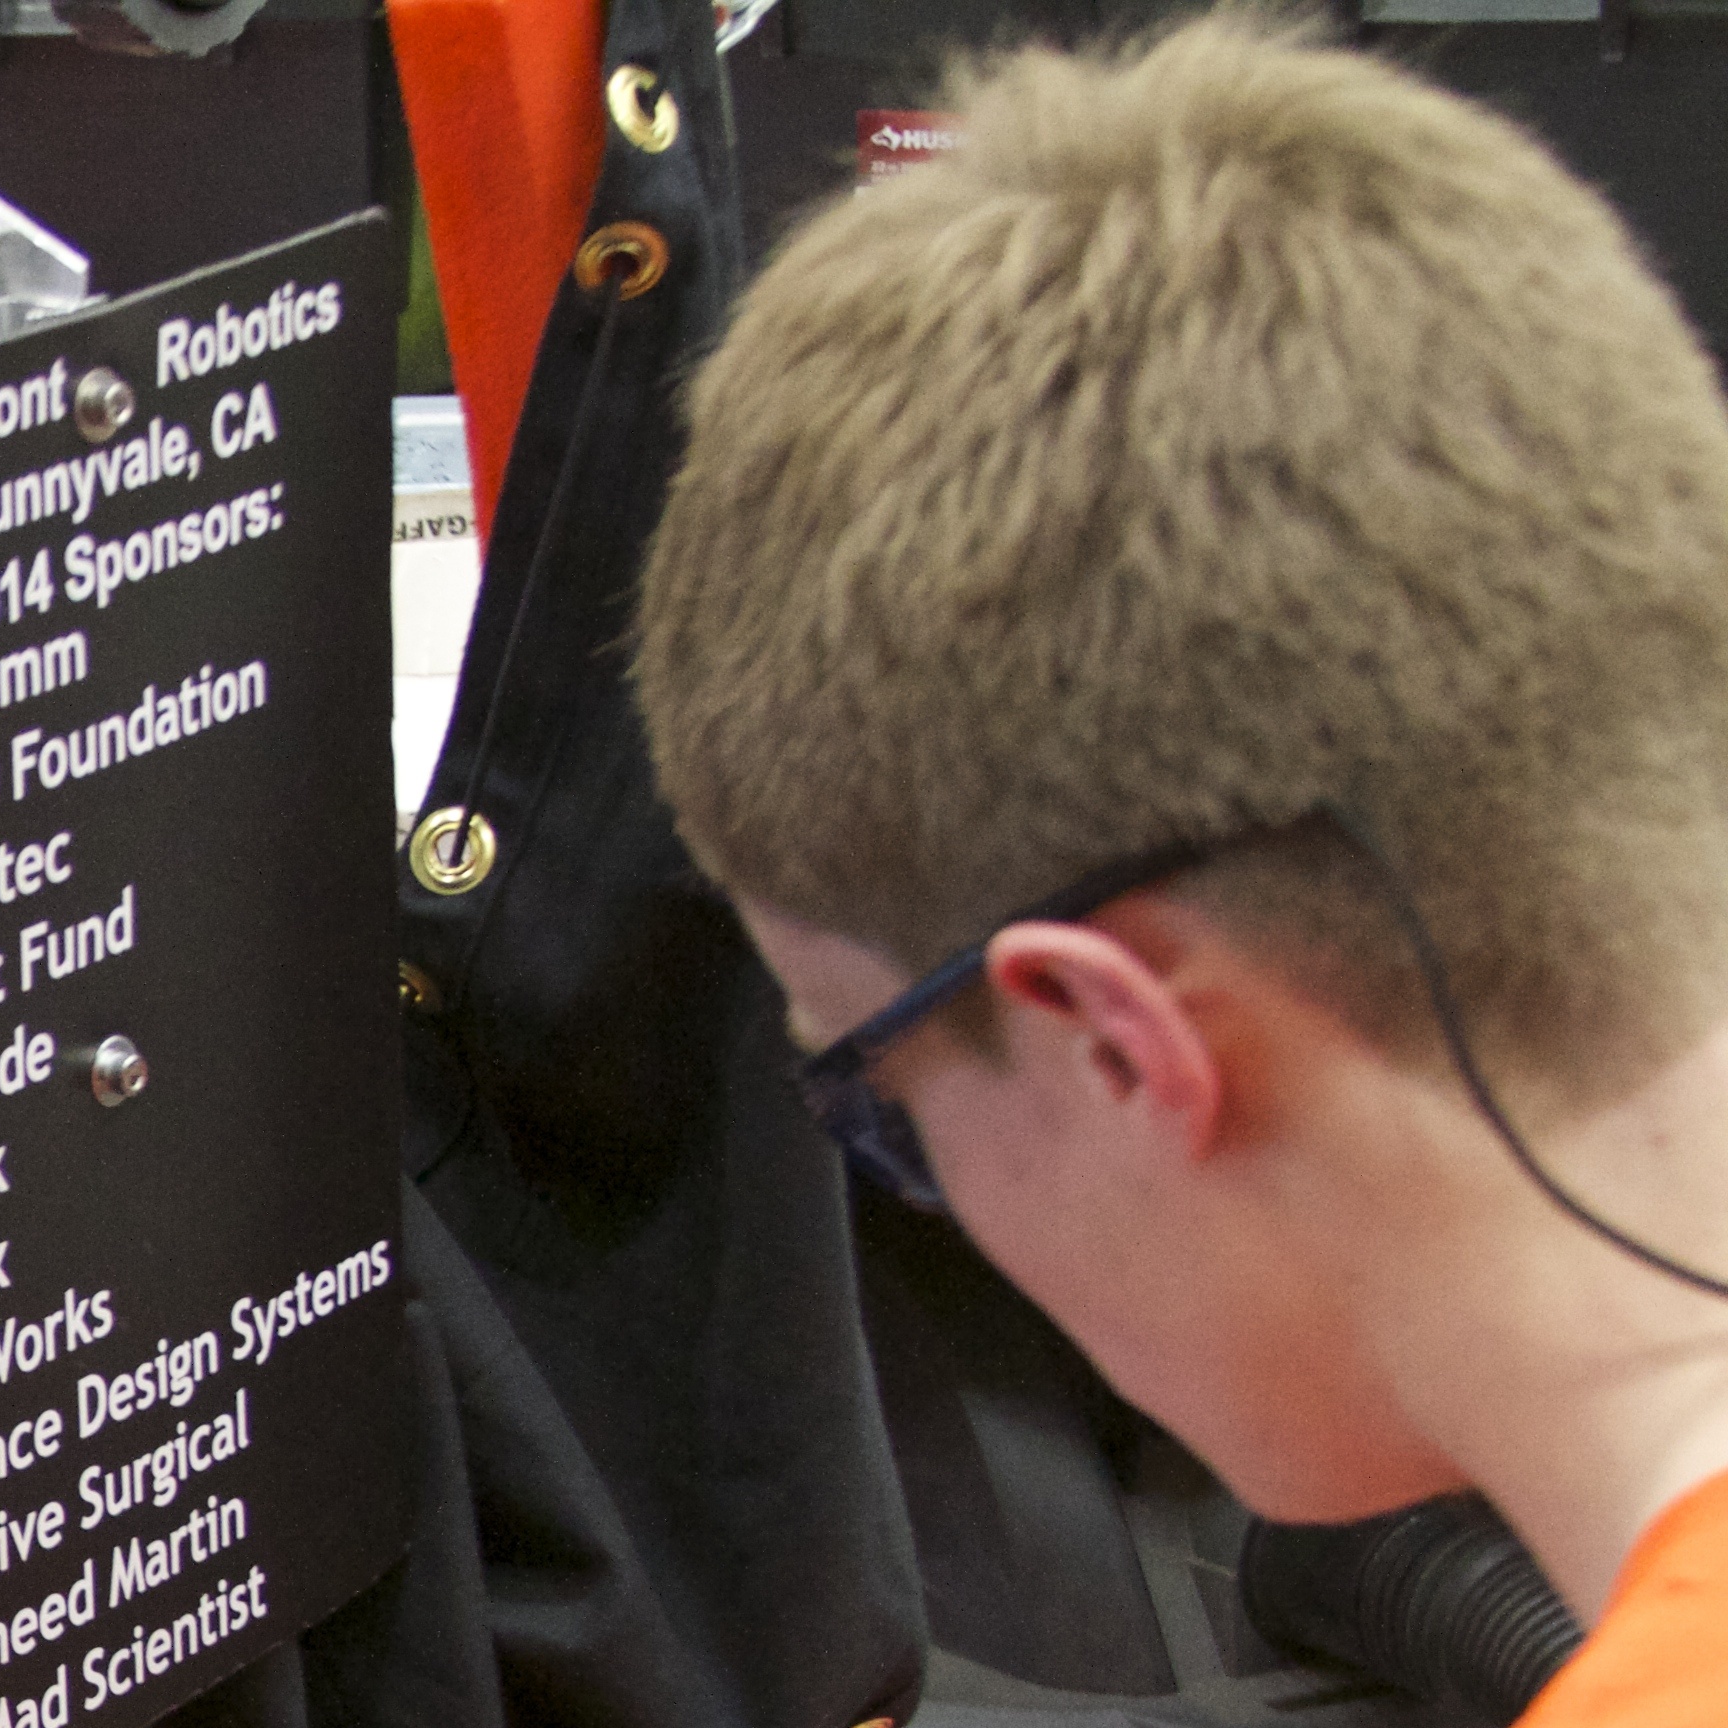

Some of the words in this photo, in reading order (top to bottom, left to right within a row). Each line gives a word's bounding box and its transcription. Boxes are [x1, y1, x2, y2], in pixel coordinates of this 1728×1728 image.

[902, 129, 968, 150] HUS
[156, 281, 340, 388] Robotics
[210, 383, 277, 459] CA
[64, 483, 285, 607] Sponsors:
[11, 661, 266, 801] Foundation
[19, 884, 134, 992] Fund
[77, 1331, 219, 1439] Design
[230, 1240, 389, 1365] Systems
[78, 1387, 249, 1530] Surgical
[108, 1495, 245, 1608] Martin
[82, 1565, 267, 1711] Scientist
